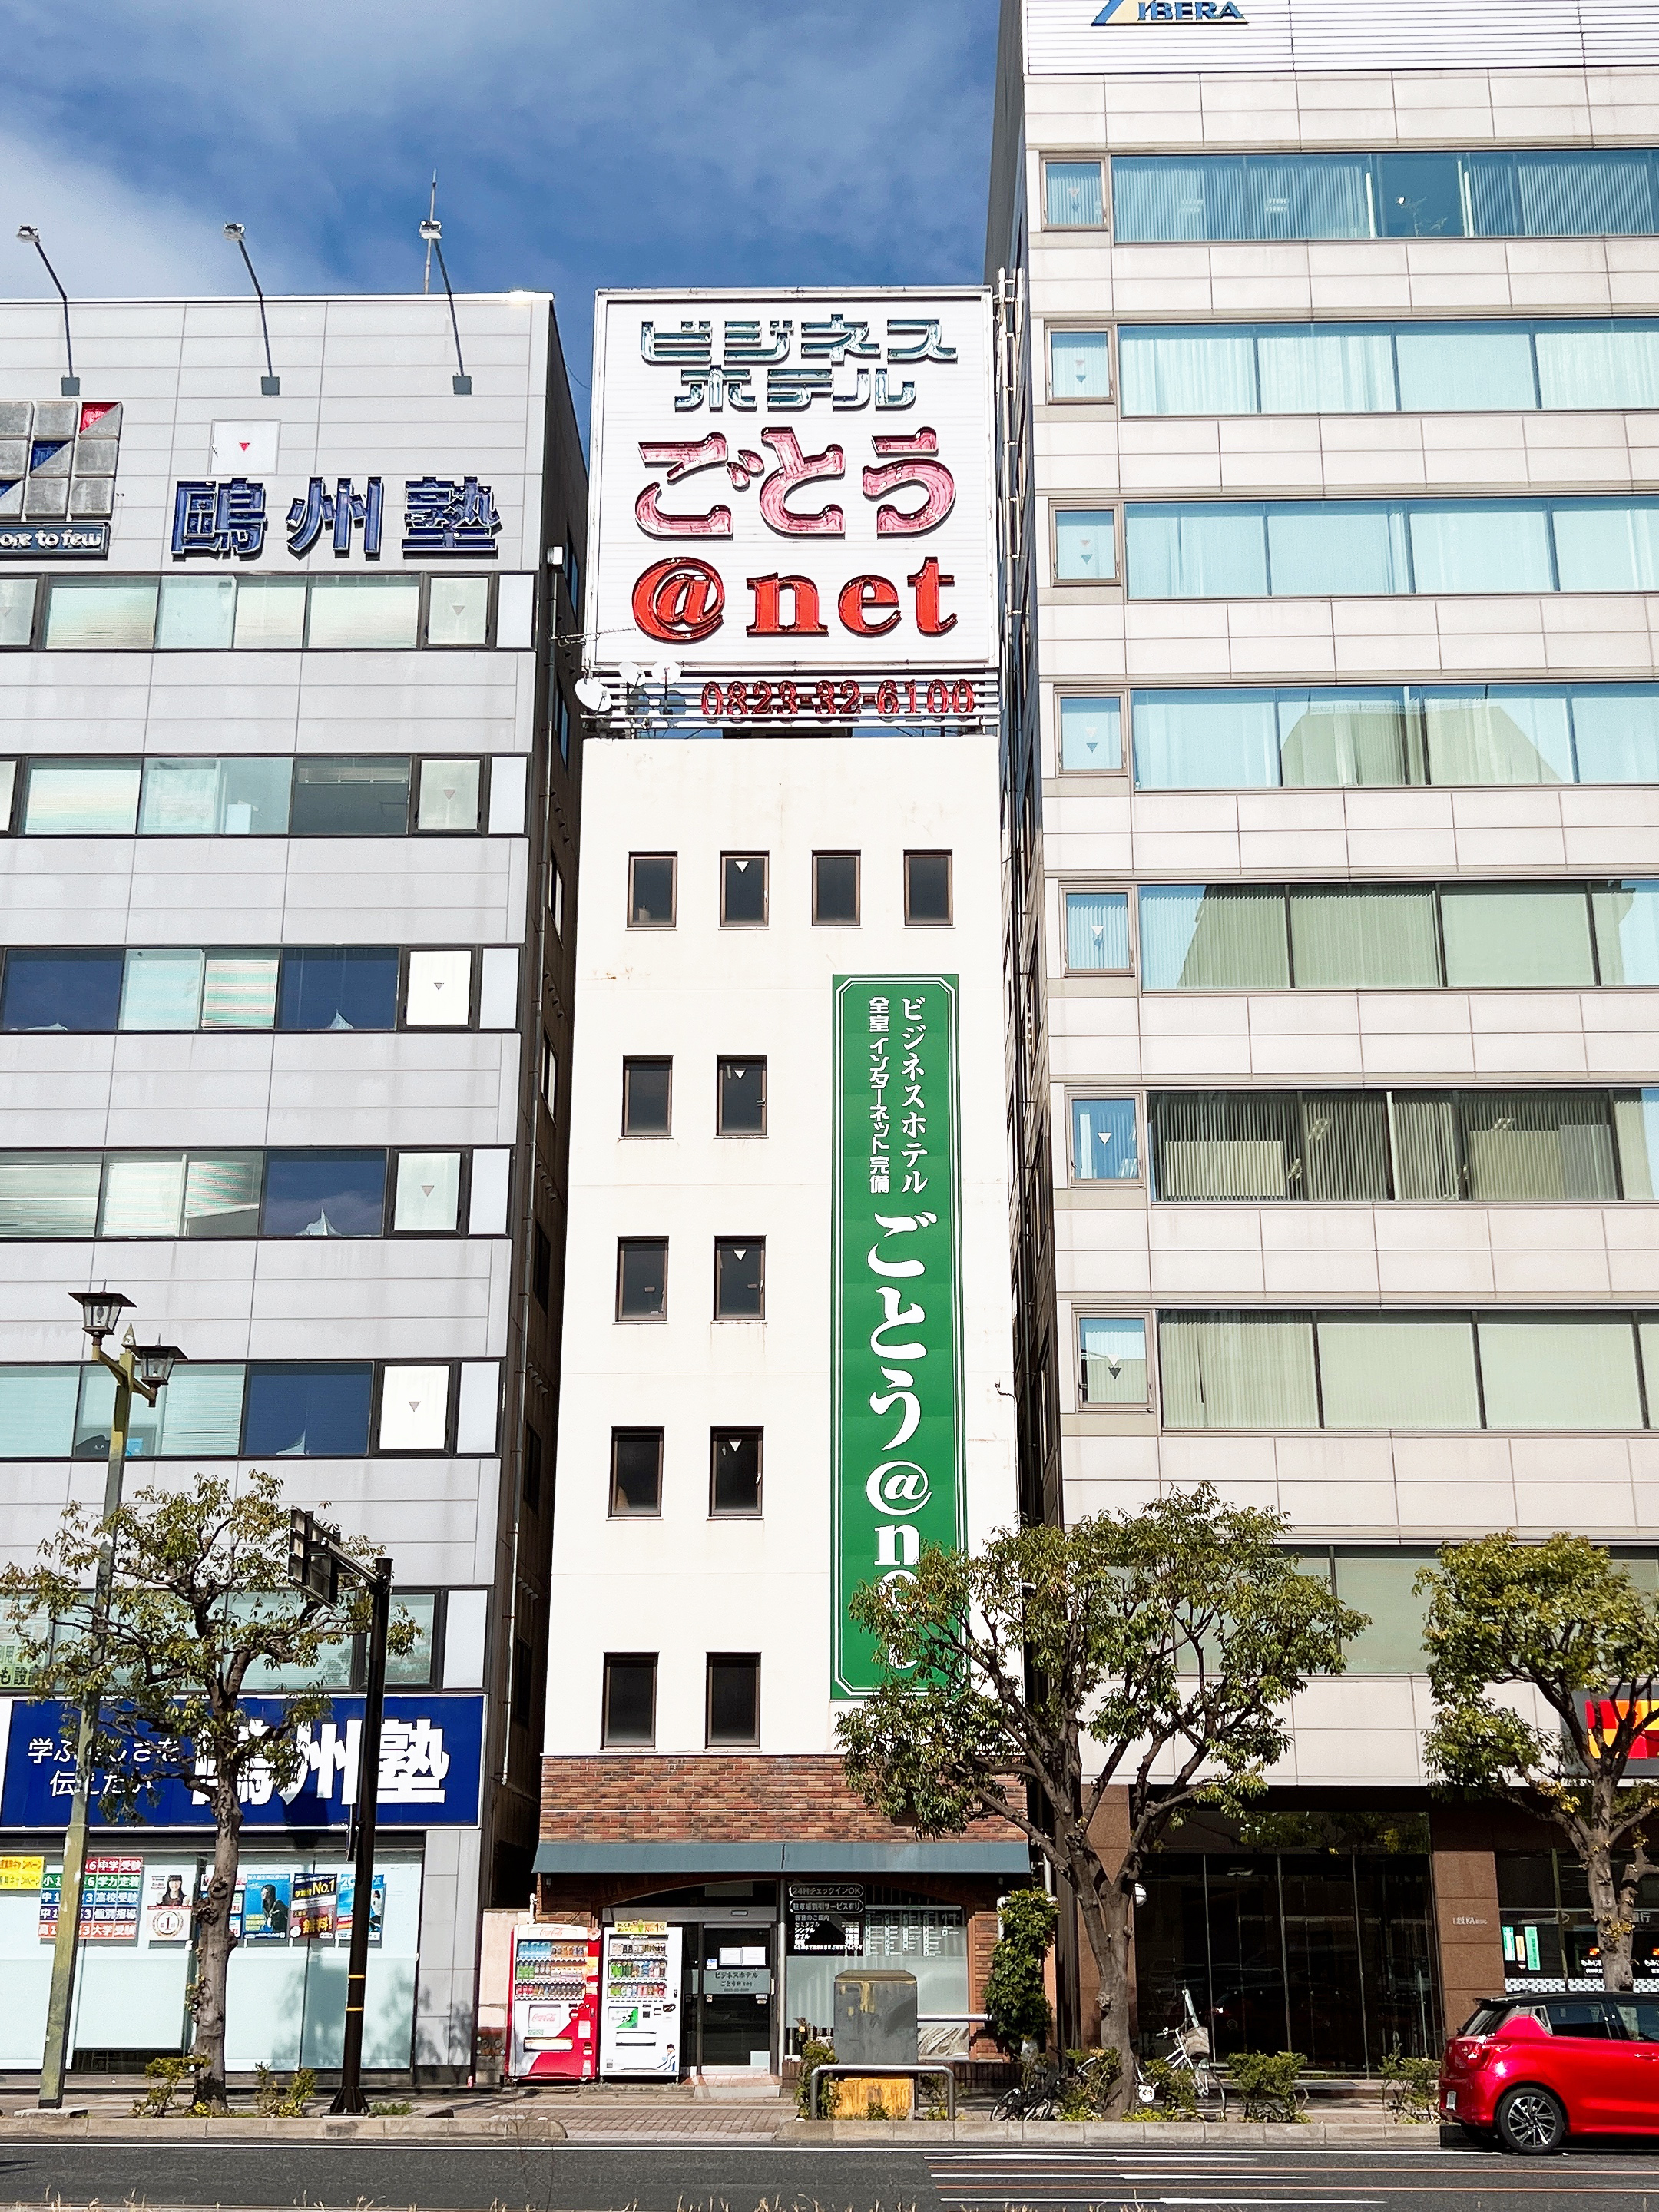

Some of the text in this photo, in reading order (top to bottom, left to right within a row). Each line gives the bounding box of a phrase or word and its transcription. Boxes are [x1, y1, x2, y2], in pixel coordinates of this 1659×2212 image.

[641, 313, 958, 365] ビジネス
[674, 365, 917, 412] ホテル
[635, 426, 957, 540] ごとう
[35, 529, 59, 548] to
[61, 528, 102, 548] few
[631, 556, 958, 645] @net
[700, 679, 977, 722] 0823-32-6100
[900, 996, 929, 1194] ビジネスホテル
[312, 1879, 335, 1895] No.1
